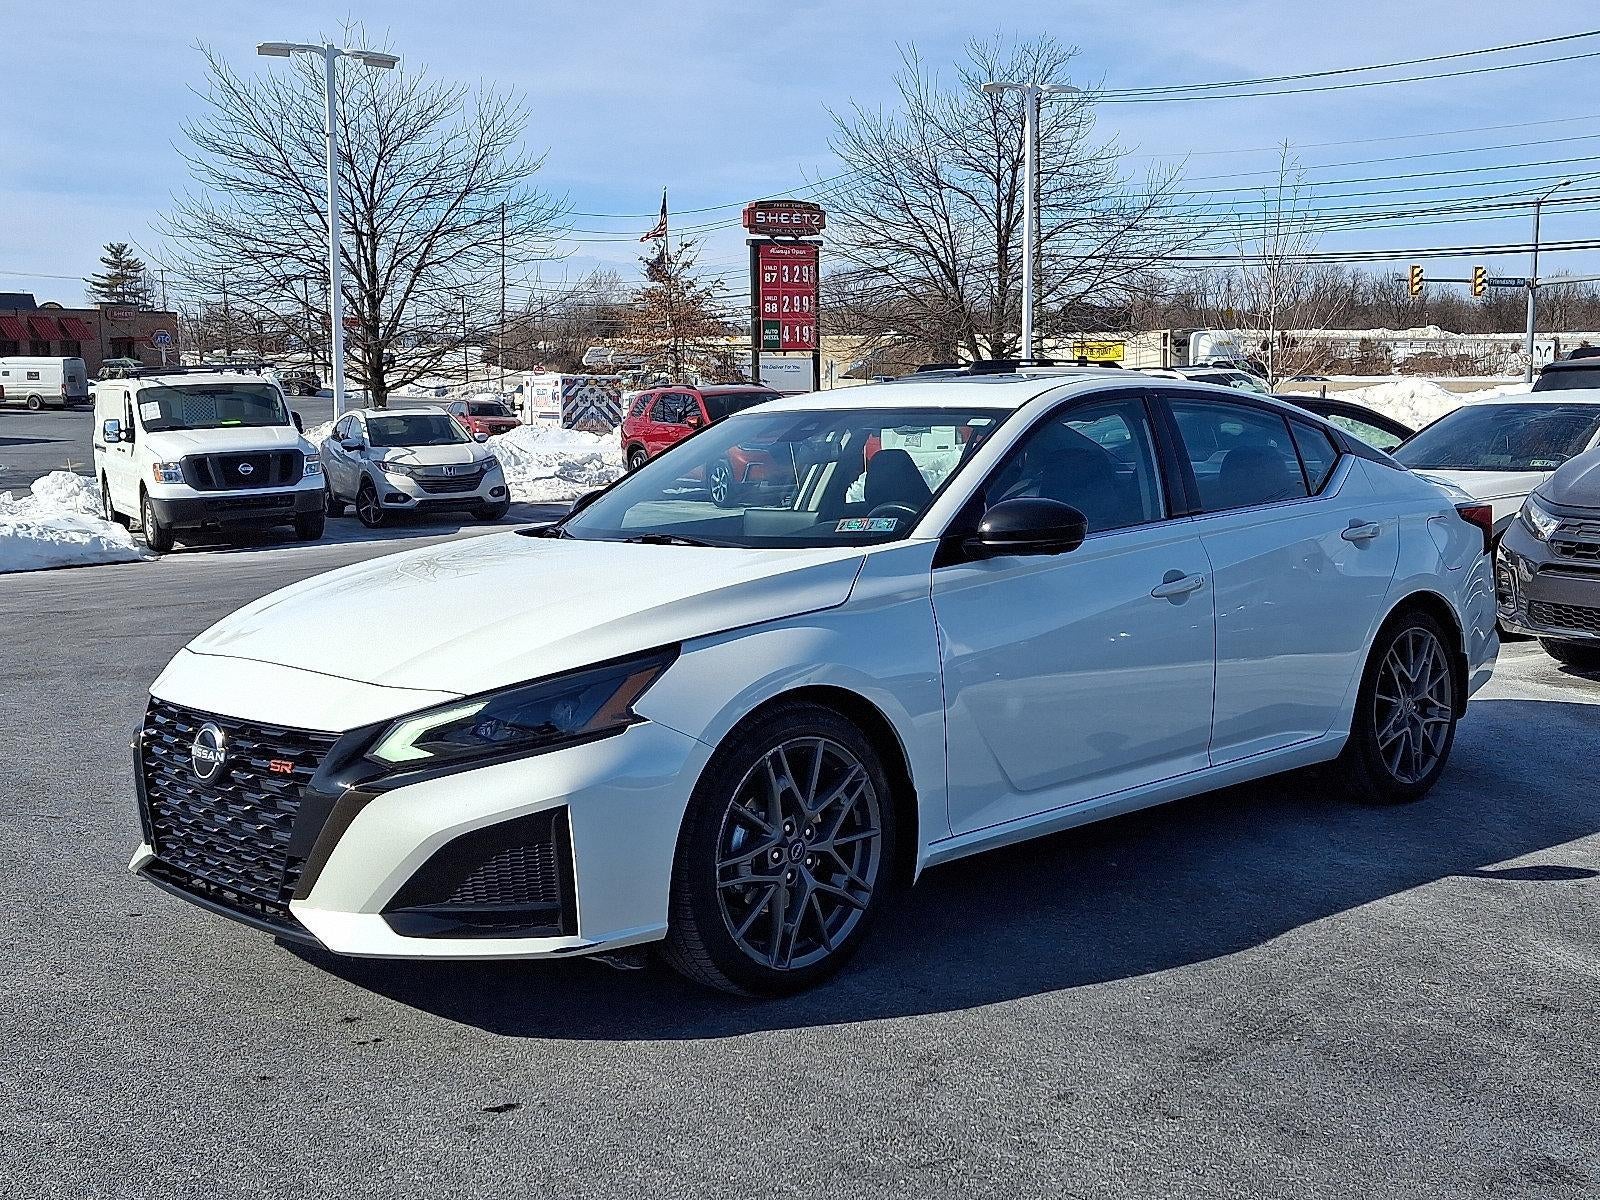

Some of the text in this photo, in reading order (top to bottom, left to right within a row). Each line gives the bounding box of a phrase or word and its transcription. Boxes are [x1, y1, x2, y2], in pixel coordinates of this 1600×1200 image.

[755, 211, 820, 225] SHEETZ
[770, 247, 790, 255] Always
[764, 272, 778, 283] 87
[764, 302, 778, 313] 88
[191, 743, 225, 763] NISSAN
[269, 759, 295, 774] SR
